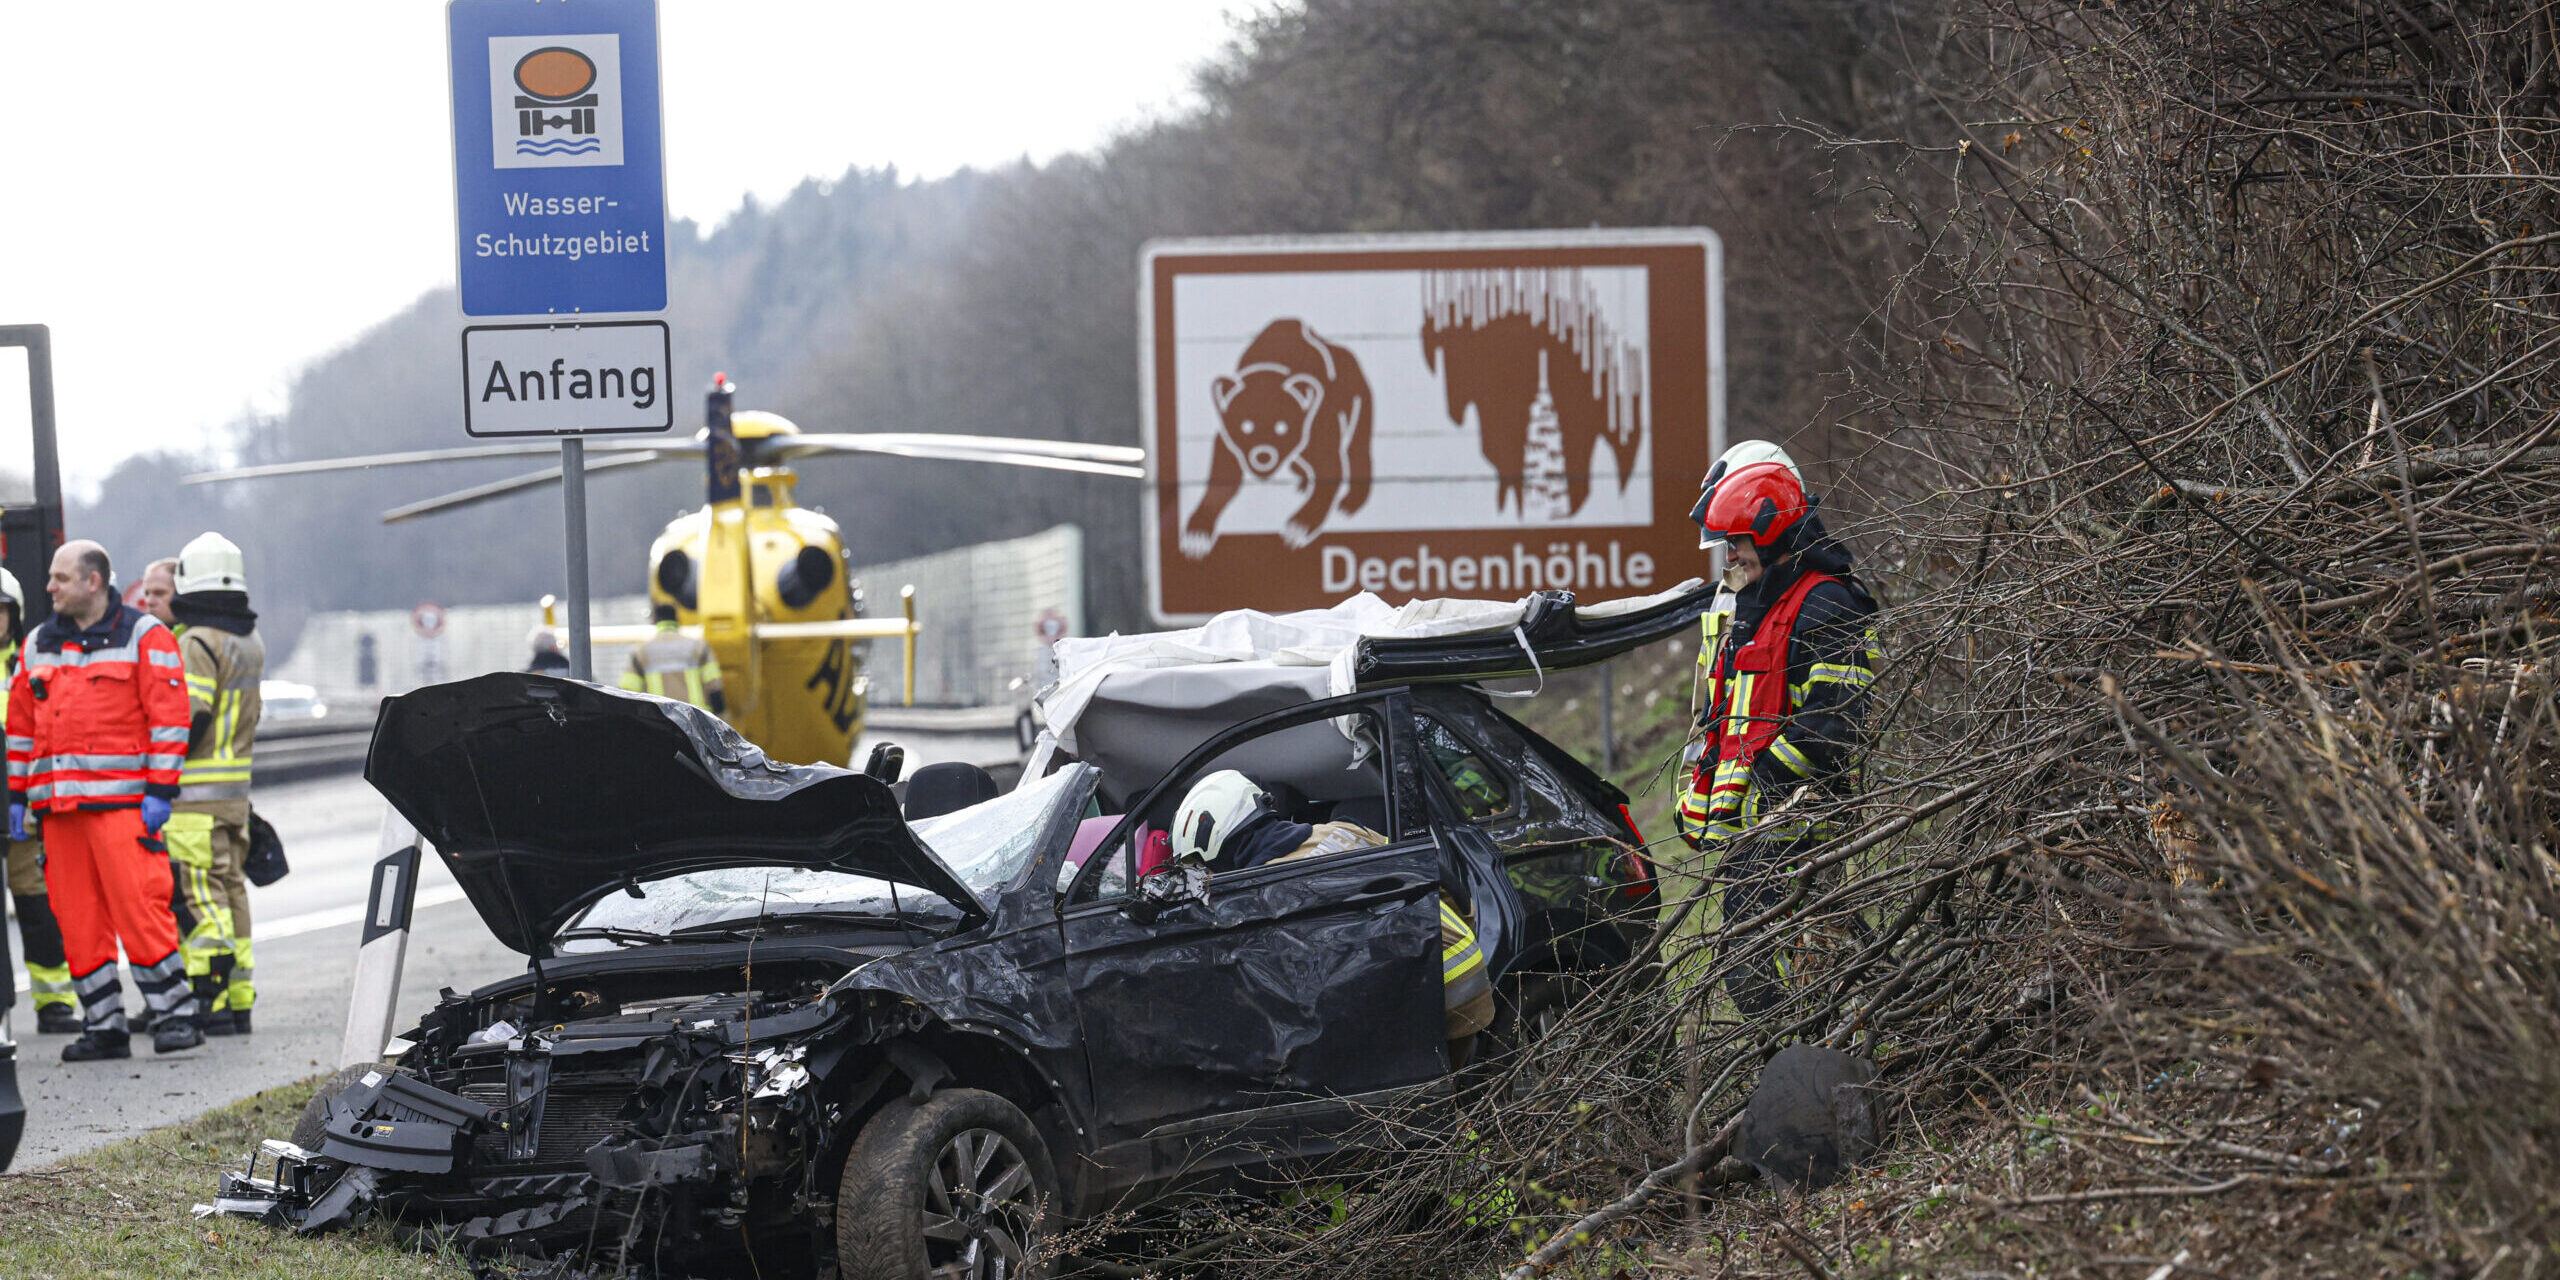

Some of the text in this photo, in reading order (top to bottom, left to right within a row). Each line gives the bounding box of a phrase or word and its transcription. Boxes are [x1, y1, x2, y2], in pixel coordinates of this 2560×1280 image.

[503, 192, 618, 217] Wasser-
[475, 230, 650, 261] Schutzgebiet
[481, 358, 656, 410] Anfang
[1321, 540, 1655, 593] Dechenhöhle
